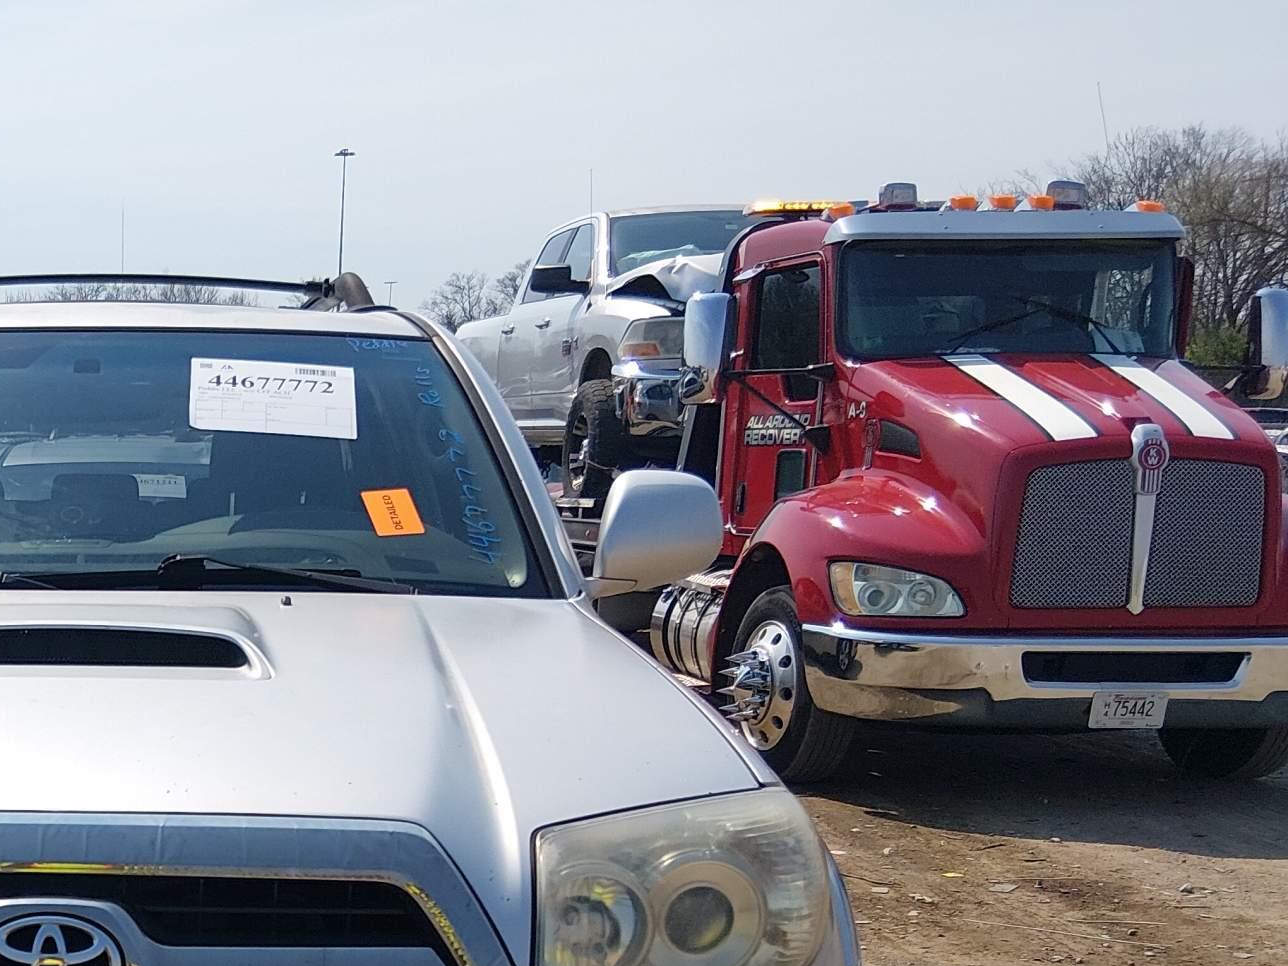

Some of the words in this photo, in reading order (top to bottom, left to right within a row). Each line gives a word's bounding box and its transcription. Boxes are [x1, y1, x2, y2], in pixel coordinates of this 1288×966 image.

[208, 373, 334, 394] 44677772
[745, 415, 764, 429] ALL
[744, 429, 806, 445] RECOVER
[382, 494, 404, 530] DETAILED
[1113, 700, 1155, 717] 75442
